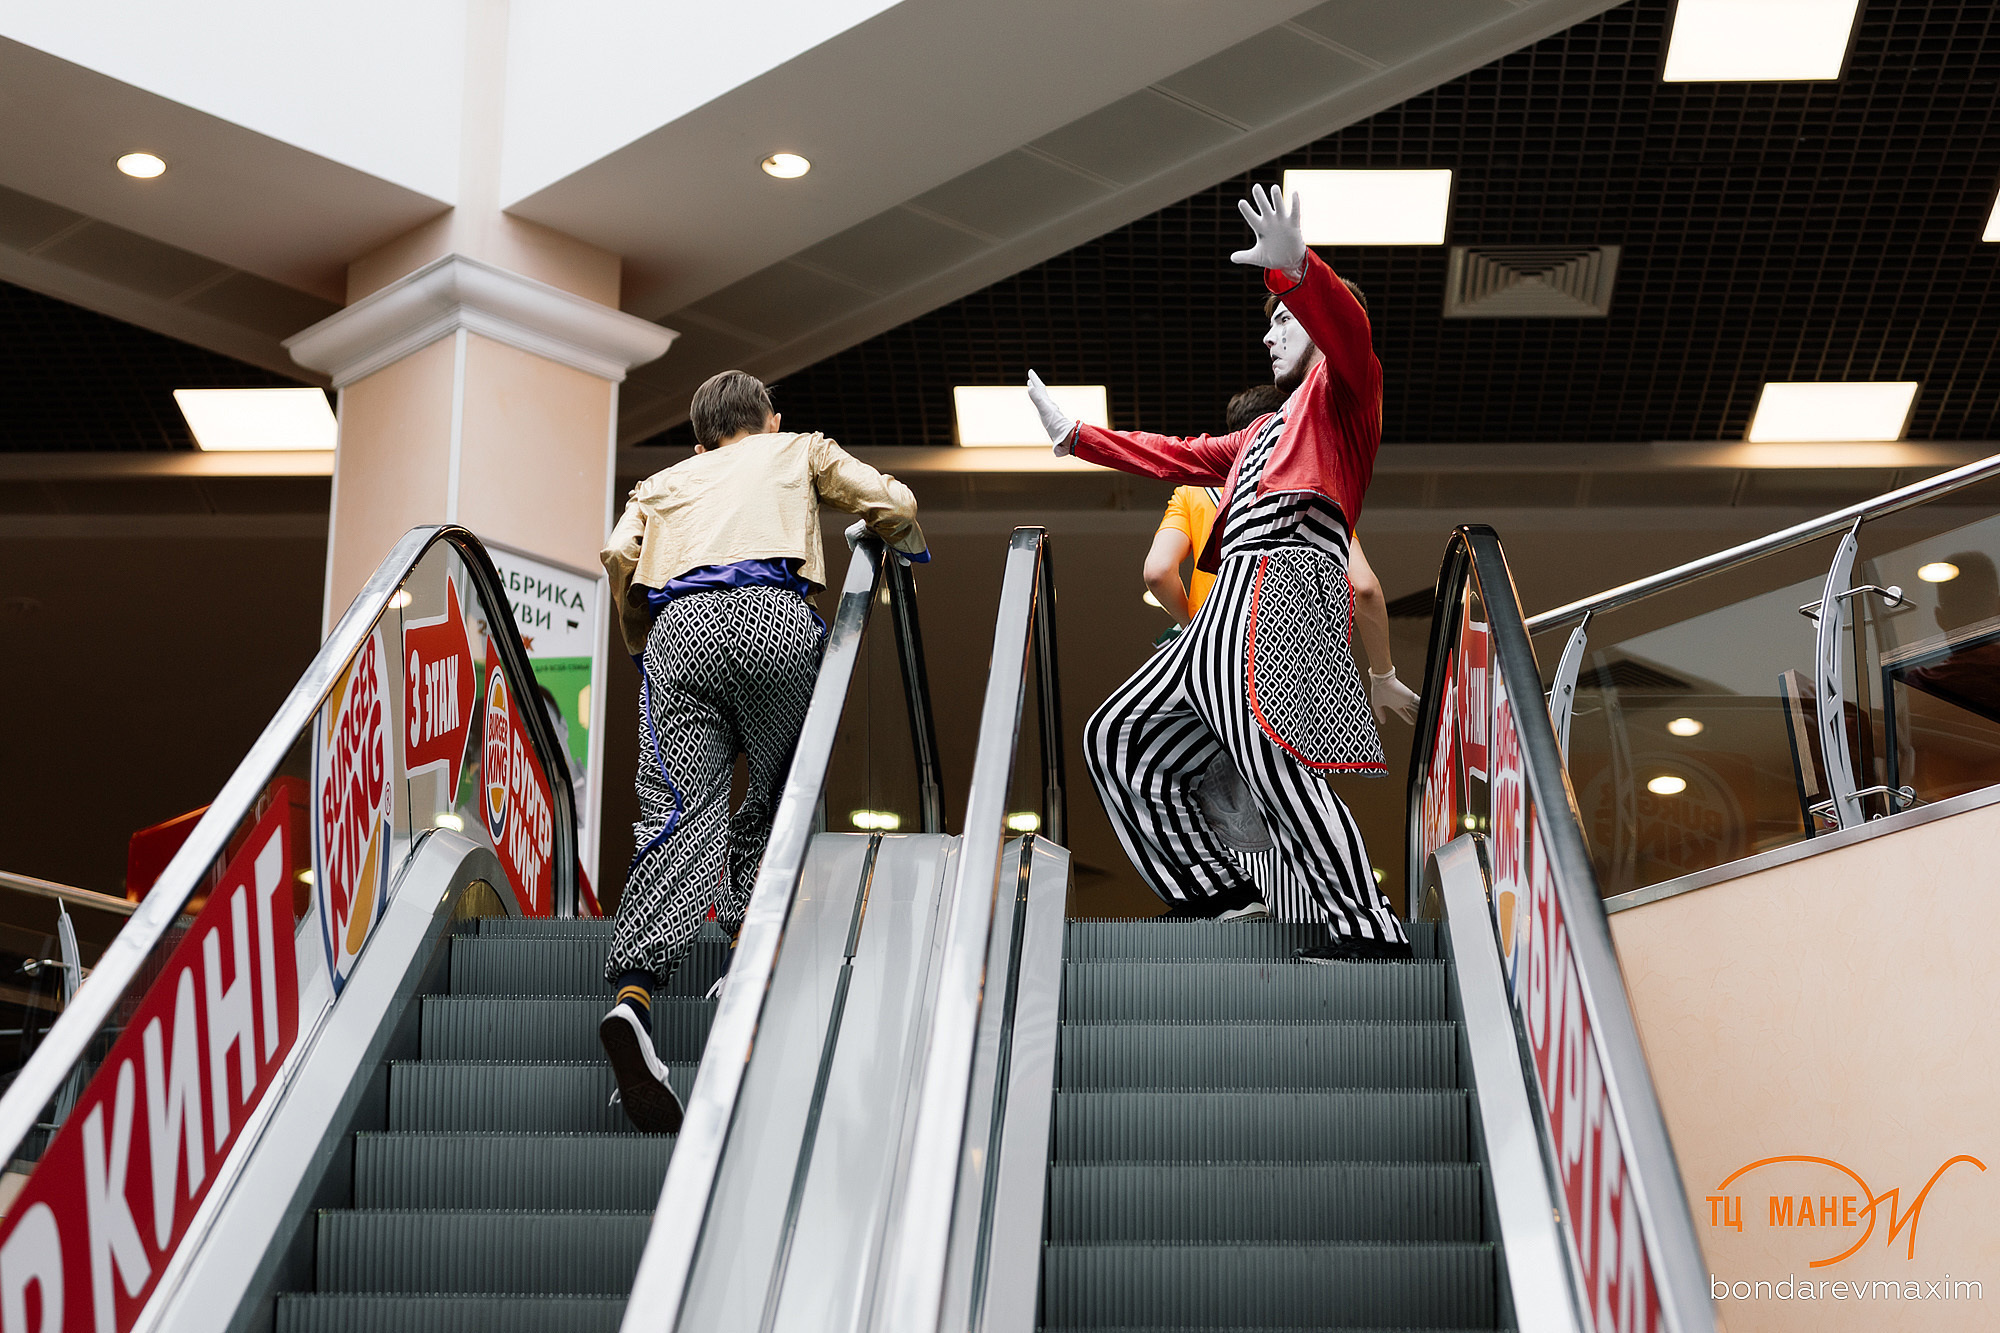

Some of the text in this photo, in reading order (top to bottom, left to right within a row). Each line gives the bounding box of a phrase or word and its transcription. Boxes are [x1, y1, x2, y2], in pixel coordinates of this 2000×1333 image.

[498, 567, 585, 612] АБРИКА
[323, 634, 378, 872] BURGER
[410, 649, 460, 748] 3 ЭТАЖ
[489, 712, 508, 747] BURGER
[488, 744, 508, 786] KING
[511, 728, 552, 864] БУРГЕР
[330, 699, 384, 970] KING
[509, 796, 541, 912] КИНГ
[1495, 778, 1520, 887] KING
[82, 825, 283, 1333] КИНГ
